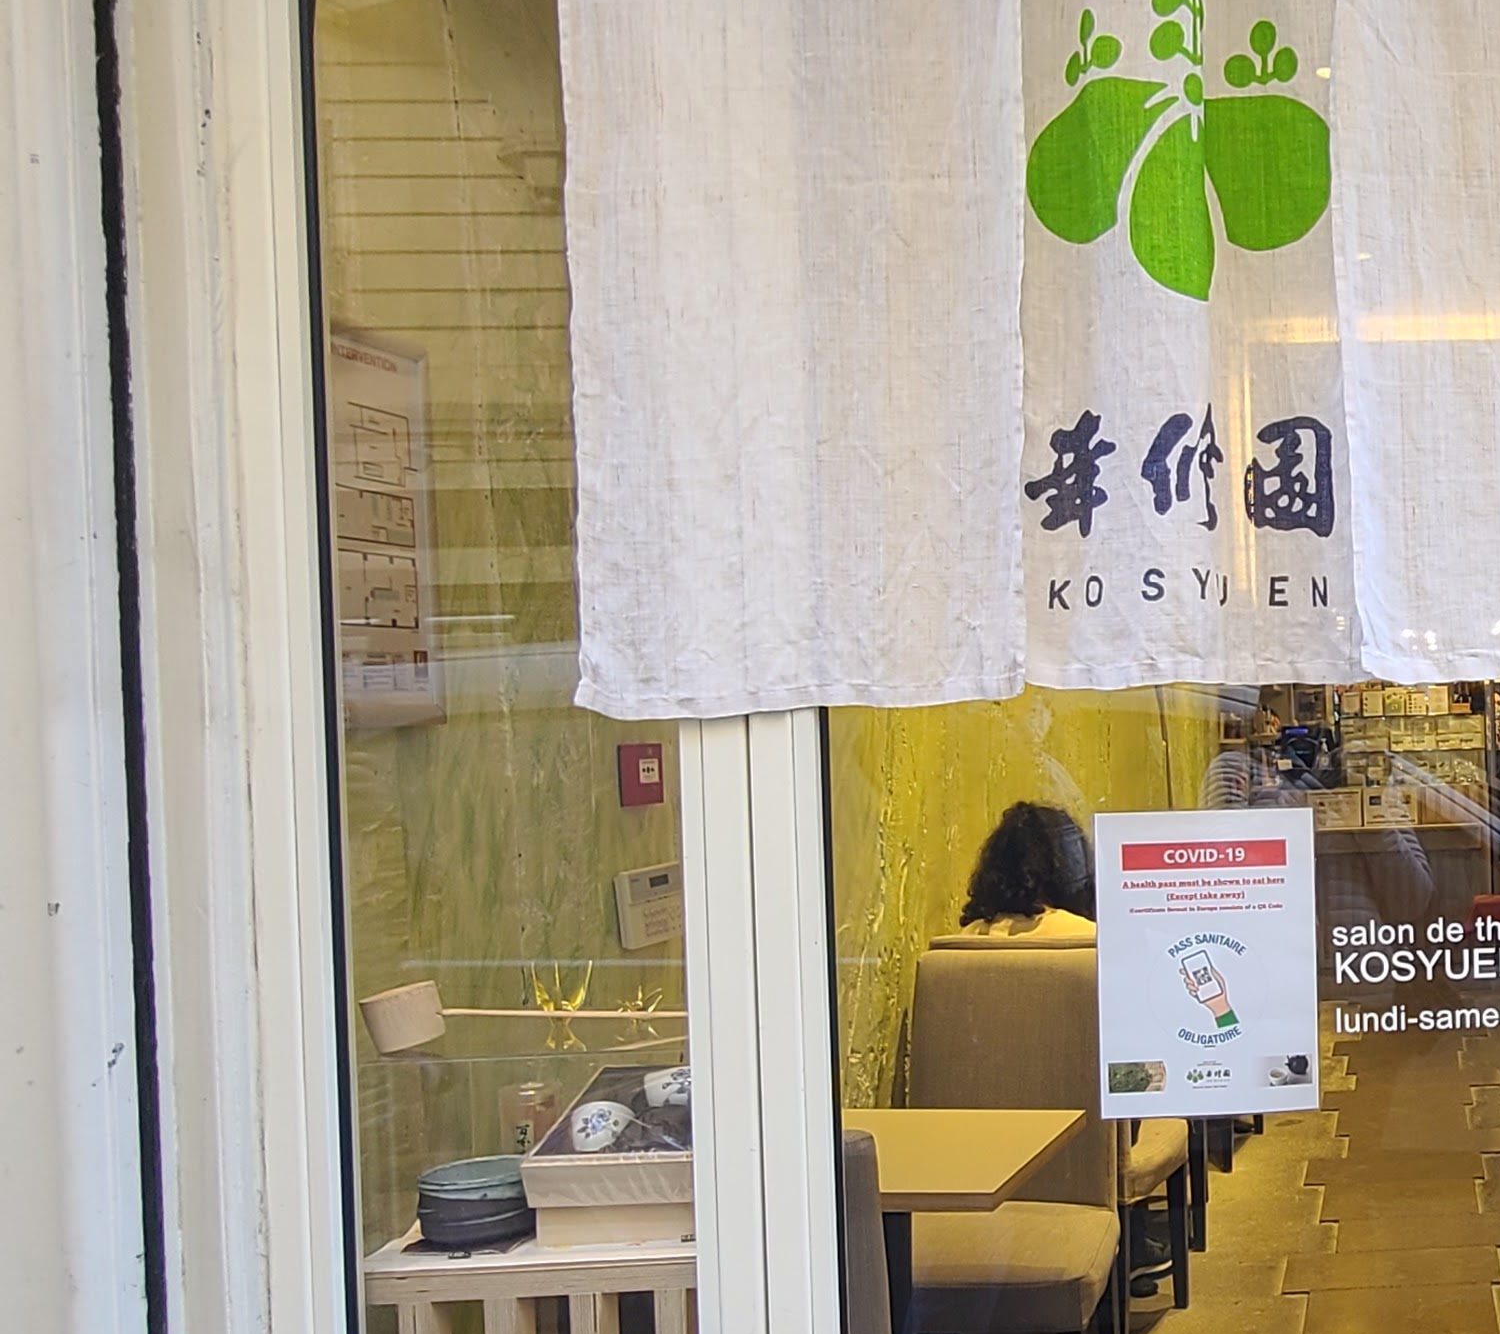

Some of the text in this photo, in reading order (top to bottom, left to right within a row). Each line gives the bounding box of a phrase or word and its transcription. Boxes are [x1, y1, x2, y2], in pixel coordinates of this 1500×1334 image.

[1048, 567, 1328, 610] KOSYUEN
[1163, 847, 1245, 864] COVID-19
[1158, 881, 1176, 889] pass
[1214, 878, 1240, 886] shown
[1166, 892, 1197, 901] (Except
[1219, 891, 1245, 900] away)
[1332, 920, 1414, 947] salon
[1426, 917, 1464, 943] de
[1168, 933, 1247, 958] PASS SANITAIRE
[1178, 1026, 1242, 1045] OBLIGATOIRE
